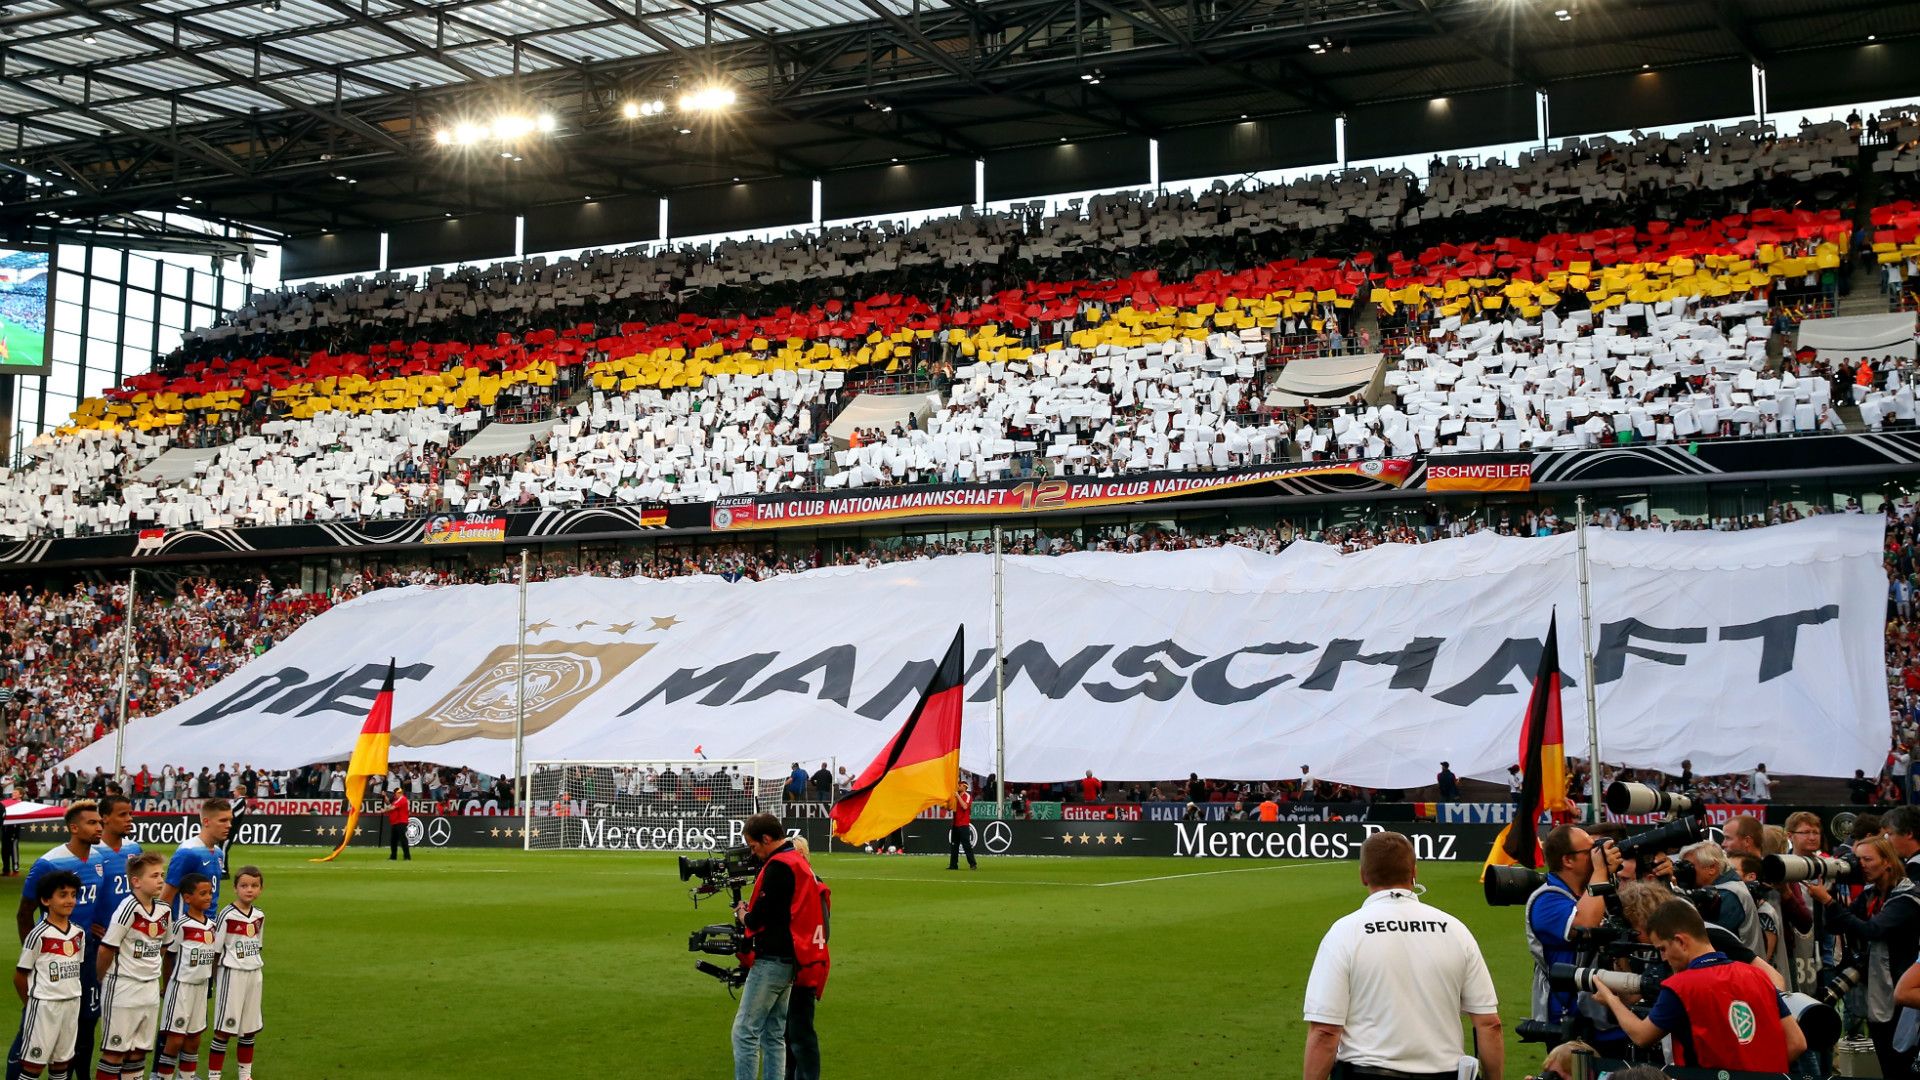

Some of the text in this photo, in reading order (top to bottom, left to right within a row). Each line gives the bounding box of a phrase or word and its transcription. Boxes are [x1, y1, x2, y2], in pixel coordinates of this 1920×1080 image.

[1427, 464, 1530, 479] ESCHWEILER
[757, 503, 784, 519] FAN
[788, 500, 824, 516] CLUB
[828, 489, 1007, 514] NATIONALMANNSCHAFT
[1012, 480, 1068, 510] 12
[1071, 484, 1102, 499] FAN
[1107, 482, 1148, 496] CLUB
[465, 513, 496, 525] Adler
[180, 604, 1840, 727] DIE MANNSCHAFT
[578, 819, 801, 850] Mercedes-Bz
[1173, 823, 1456, 861] Mercedes-nz
[80, 885, 97, 905] 14
[812, 924, 826, 949] 4
[1364, 920, 1448, 934] SECURITY
